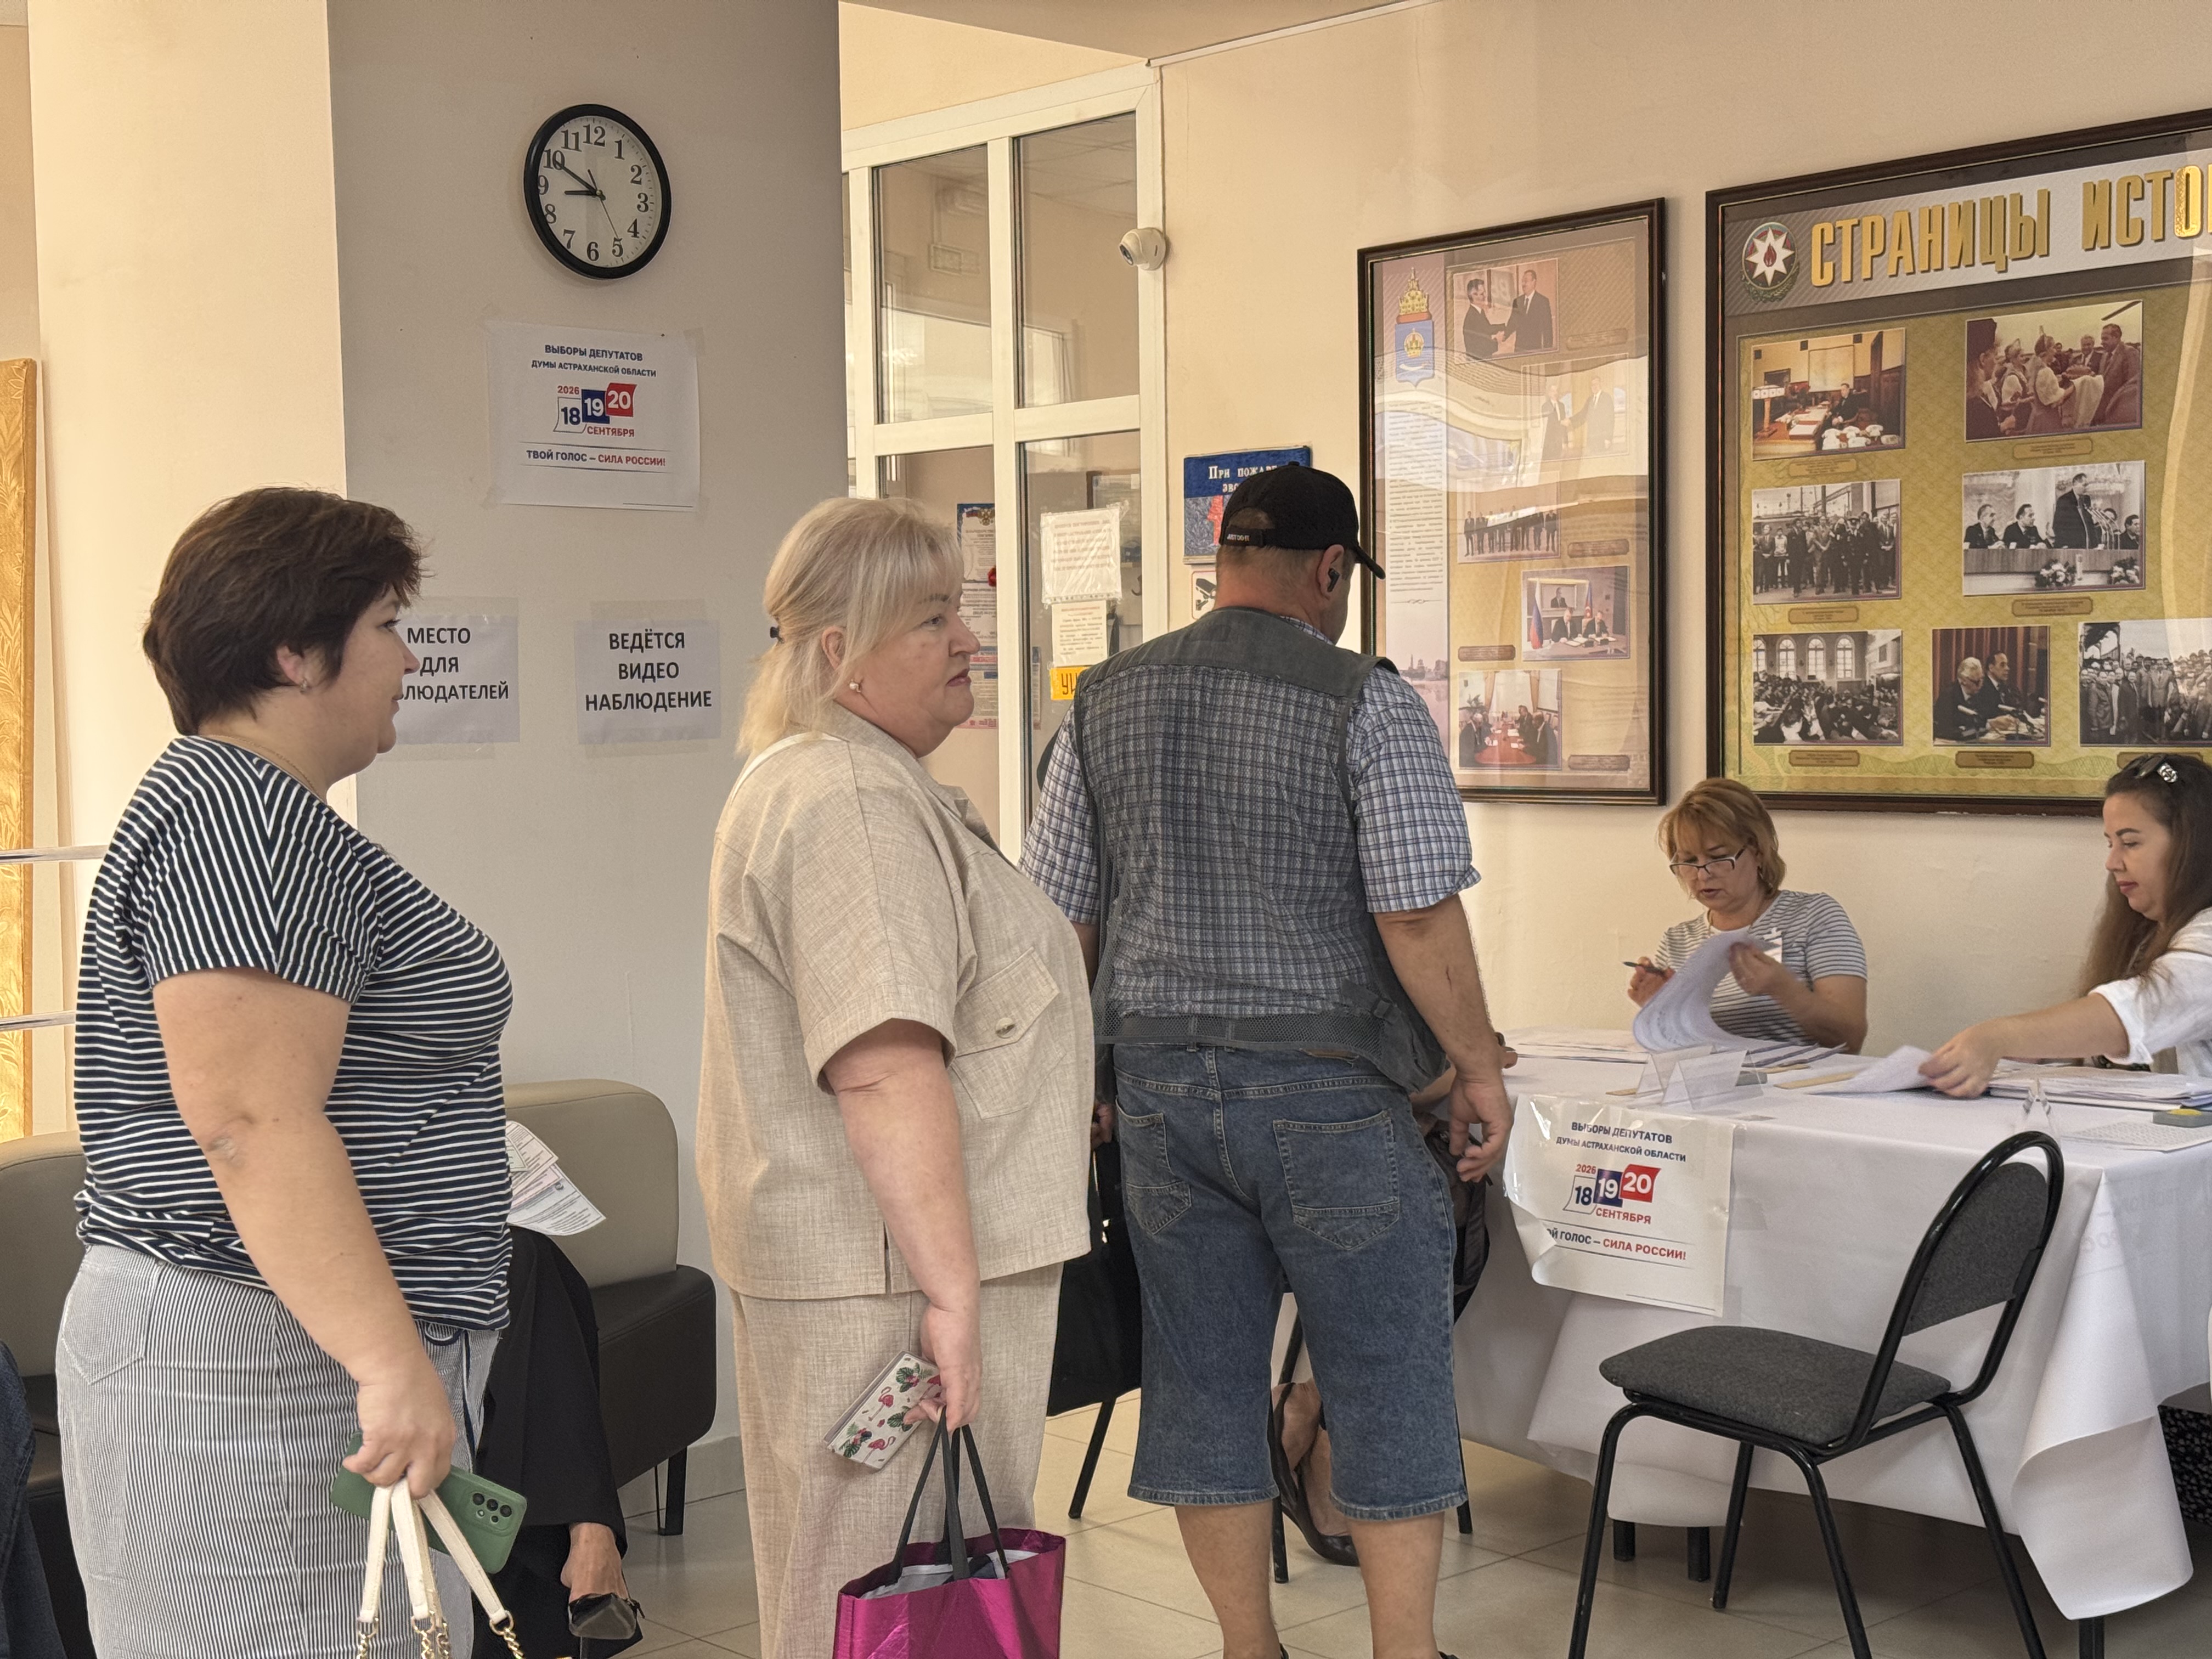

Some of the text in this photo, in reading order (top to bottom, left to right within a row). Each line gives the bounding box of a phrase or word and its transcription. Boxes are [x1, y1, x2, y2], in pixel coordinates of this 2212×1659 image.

[561, 129, 582, 152] 11
[583, 124, 605, 147] 12
[543, 149, 565, 170] 10
[614, 139, 624, 160] 1
[538, 175, 549, 195] 9
[630, 165, 642, 185] 2
[637, 193, 648, 212] 3
[544, 204, 556, 224] 8
[627, 218, 639, 238] 4
[1812, 163, 2212, 286] СТРАНИЦЫ ИСТО
[563, 229, 575, 249] 7
[612, 238, 623, 257] 5
[587, 242, 599, 261] 6
[545, 345, 643, 361] ВЫБОРЫ ДЕПУТАТОВ
[532, 360, 656, 377] ДУМЫ АСТРАХАНСКОЙ ОБЛАСТИ
[557, 386, 579, 395] 2026
[561, 391, 631, 425] 18 19 20
[587, 426, 635, 437] СЕНТЯБРЯ
[526, 449, 554, 460] ТВОЙ
[556, 452, 587, 461] ГОЛОС
[598, 454, 623, 464] СИЛА
[625, 456, 665, 466] РОССИИ!
[407, 628, 471, 644] МЕСТО
[609, 629, 685, 653] ВЕДЁТСЯ
[420, 657, 459, 676] ДЛЯ
[619, 662, 679, 683] ВИДЕО
[404, 681, 509, 703] ЛЮДАТЕЛЕЙ
[586, 691, 712, 713] НАБЛЮДЕНИЕ
[1571, 1122, 1672, 1144] ВЫБОРЫ ДЕПУТАТОВ
[1556, 1137, 1686, 1162] ДУМЫ АСТРАХАНСКОЙ ОБЛАСТИ
[1575, 1164, 1596, 1174] 2026
[1575, 1172, 1651, 1205] 18 19 20
[1596, 1207, 1651, 1224] СЕНТЯБРЯ
[1560, 1231, 1592, 1244] ГОЛОС
[1603, 1239, 1632, 1251] СИЛА
[1636, 1244, 1686, 1260] РОССИИ!
